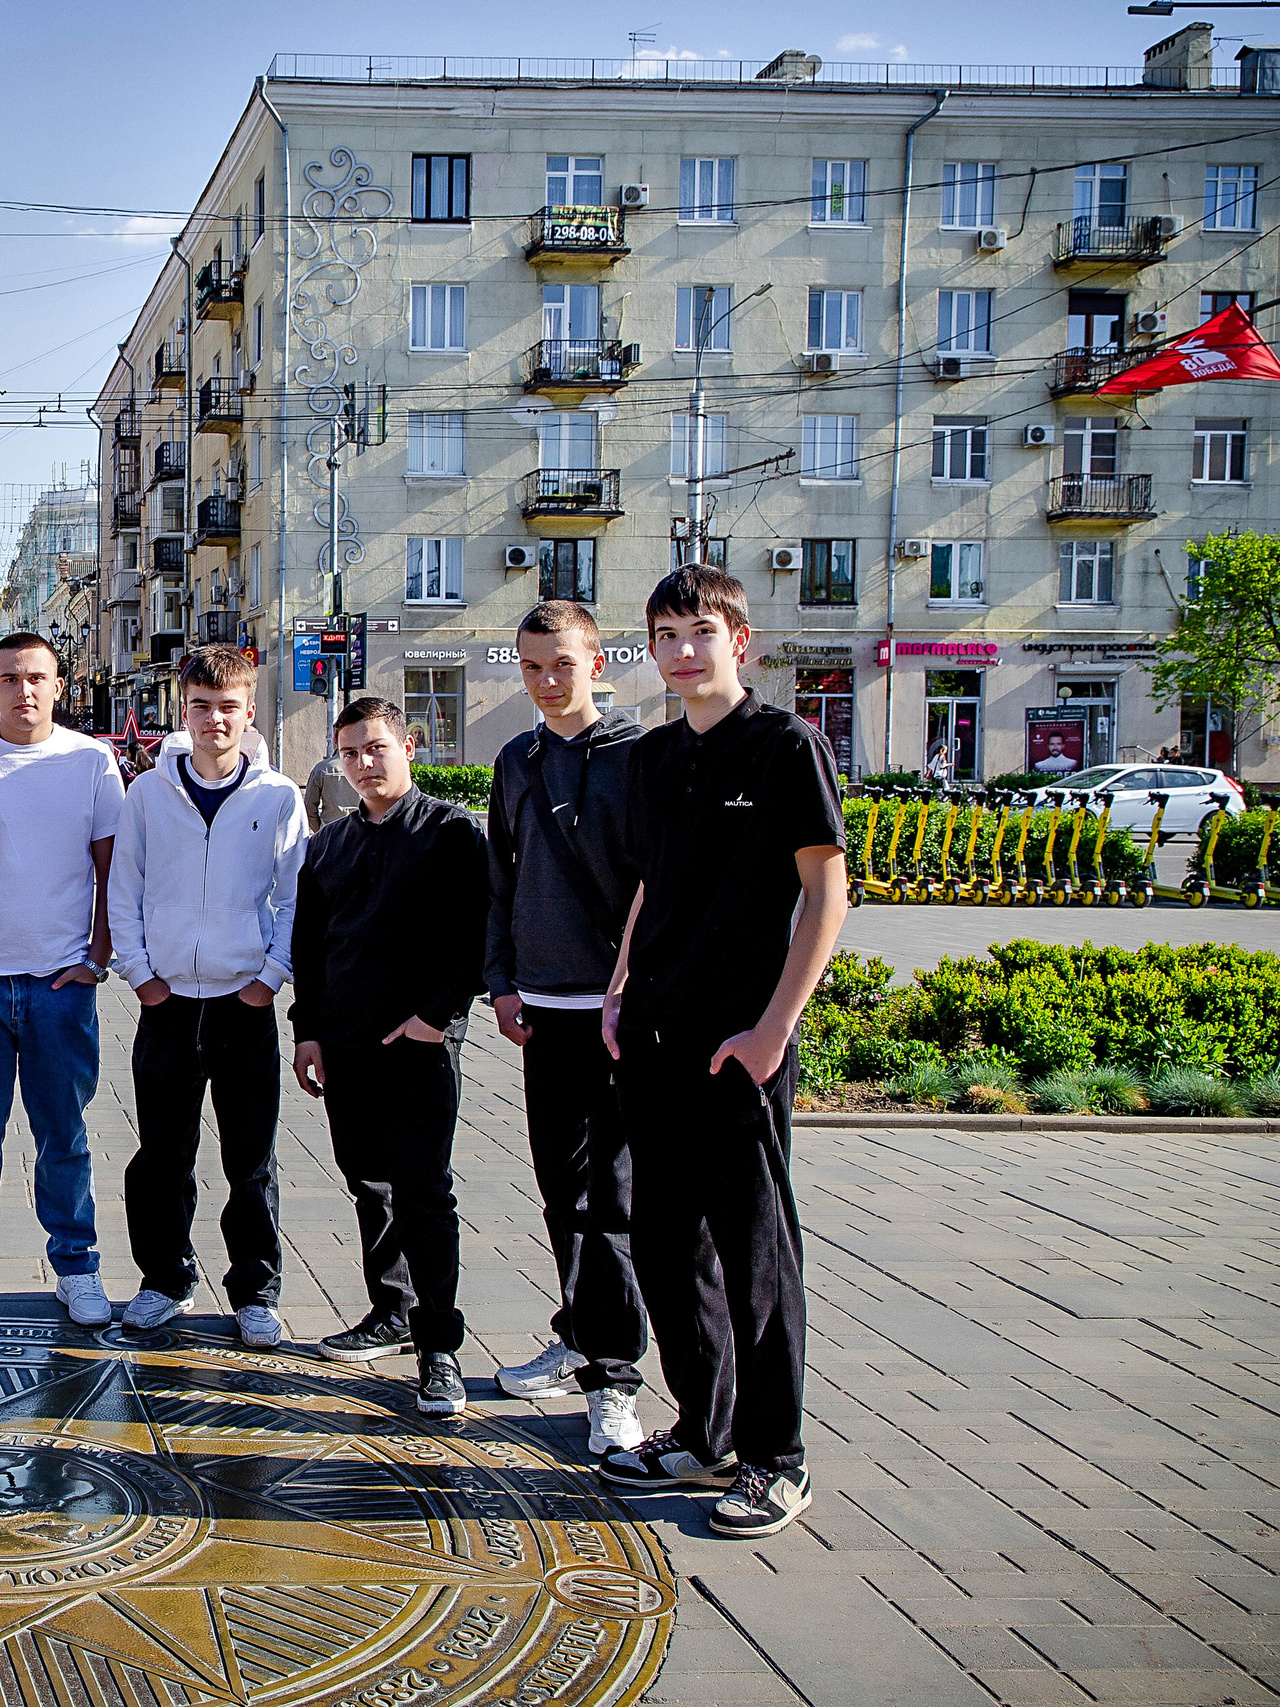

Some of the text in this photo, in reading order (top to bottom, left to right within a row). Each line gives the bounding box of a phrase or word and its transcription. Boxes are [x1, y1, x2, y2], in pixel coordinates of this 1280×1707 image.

[1180, 354, 1205, 371] 80
[1190, 361, 1237, 379] ПОБЕДА!
[322, 634, 346, 642] ЖДИТЕ
[1022, 643, 1095, 655] индустрия
[404, 648, 467, 660] ювелирный
[487, 647, 521, 664] 585
[475, 1518, 526, 1562] 2227
[559, 1523, 610, 1558] РИМ
[567, 1571, 643, 1613] W
[429, 1605, 513, 1663] 2764
[516, 1621, 606, 1698] ПАРИЖ
